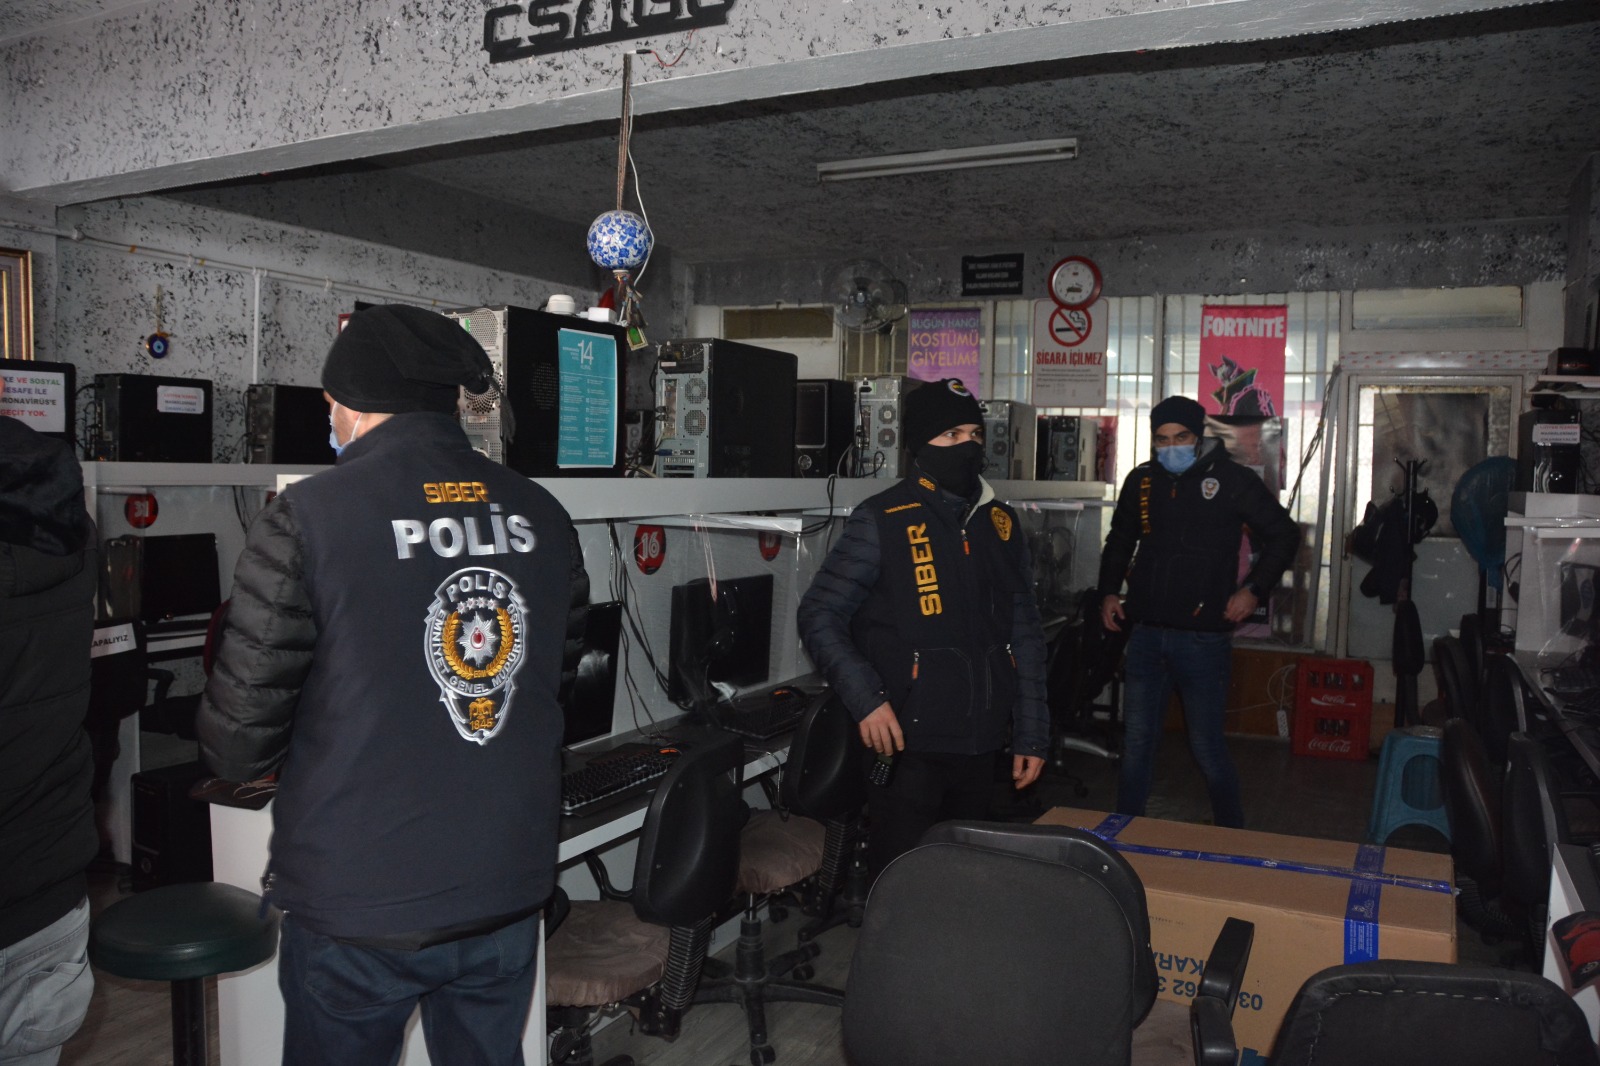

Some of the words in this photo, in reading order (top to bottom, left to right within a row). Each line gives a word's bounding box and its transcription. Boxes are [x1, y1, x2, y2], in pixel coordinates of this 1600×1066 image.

[1202, 315, 1285, 338] FORTNITE
[911, 329, 979, 347] KOSTÜMÜ
[577, 339, 594, 365] 14
[1036, 349, 1067, 365] SİGARA
[1069, 349, 1103, 367] İÇİLMEZ
[29, 378, 61, 386] SOSYAL
[0, 397, 57, 406] RONAVİRÜS'E
[391, 502, 537, 560] POLİS
[640, 531, 661, 559] 16
[446, 573, 509, 602] POLİS
[91, 634, 129, 648] APALIYIZ
[449, 675, 491, 694] GENEL
[469, 718, 494, 731] 1845
